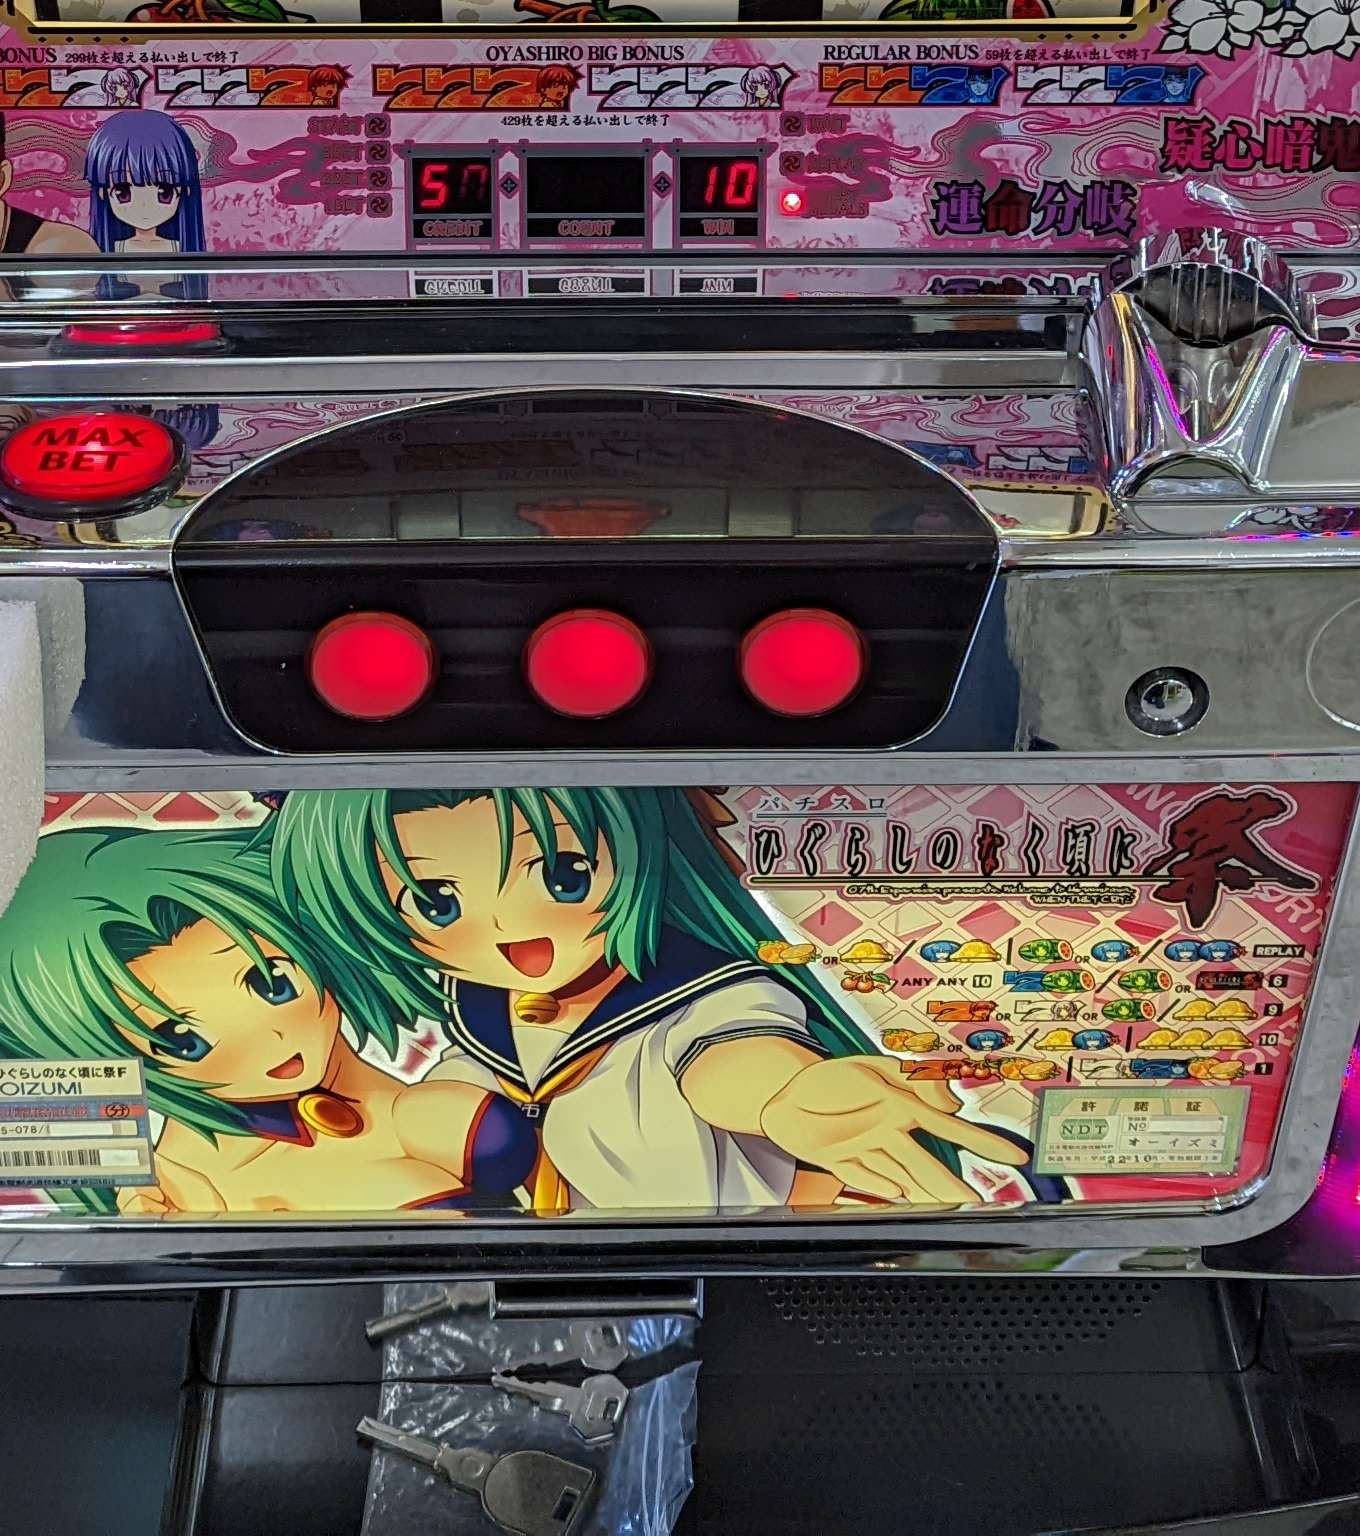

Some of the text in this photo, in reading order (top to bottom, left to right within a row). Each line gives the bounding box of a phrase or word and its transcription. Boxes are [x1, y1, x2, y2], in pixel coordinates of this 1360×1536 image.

[485, 45, 685, 62] OYASHIRO BIG BONUS
[823, 45, 980, 61] REGULAR BONUS
[704, 163, 758, 205] 10
[932, 181, 1137, 236] 運命分岐
[422, 219, 484, 237] CREDIT
[557, 219, 615, 236] COUNT
[31, 427, 151, 448] MAX
[37, 450, 133, 472] BET
[760, 795, 886, 810] パチスロ
[752, 820, 1139, 876] ひぐらしのなく頃に
[1254, 946, 1304, 957] REPLAY
[822, 956, 839, 966] OR
[1074, 955, 1091, 964] OR
[901, 975, 992, 987] ANY ANY 10
[1271, 975, 1283, 986] 6
[1175, 984, 1192, 994] OR
[1267, 1004, 1278, 1015] 9
[995, 1012, 1011, 1022] OR
[1082, 1012, 1098, 1021] OR
[1259, 1034, 1277, 1045] 10
[947, 1044, 963, 1053] OR
[0, 1081, 83, 1096] OIZUMI
[1061, 1124, 1107, 1135] NDT
[1128, 1137, 1218, 1148] オーイズミ
